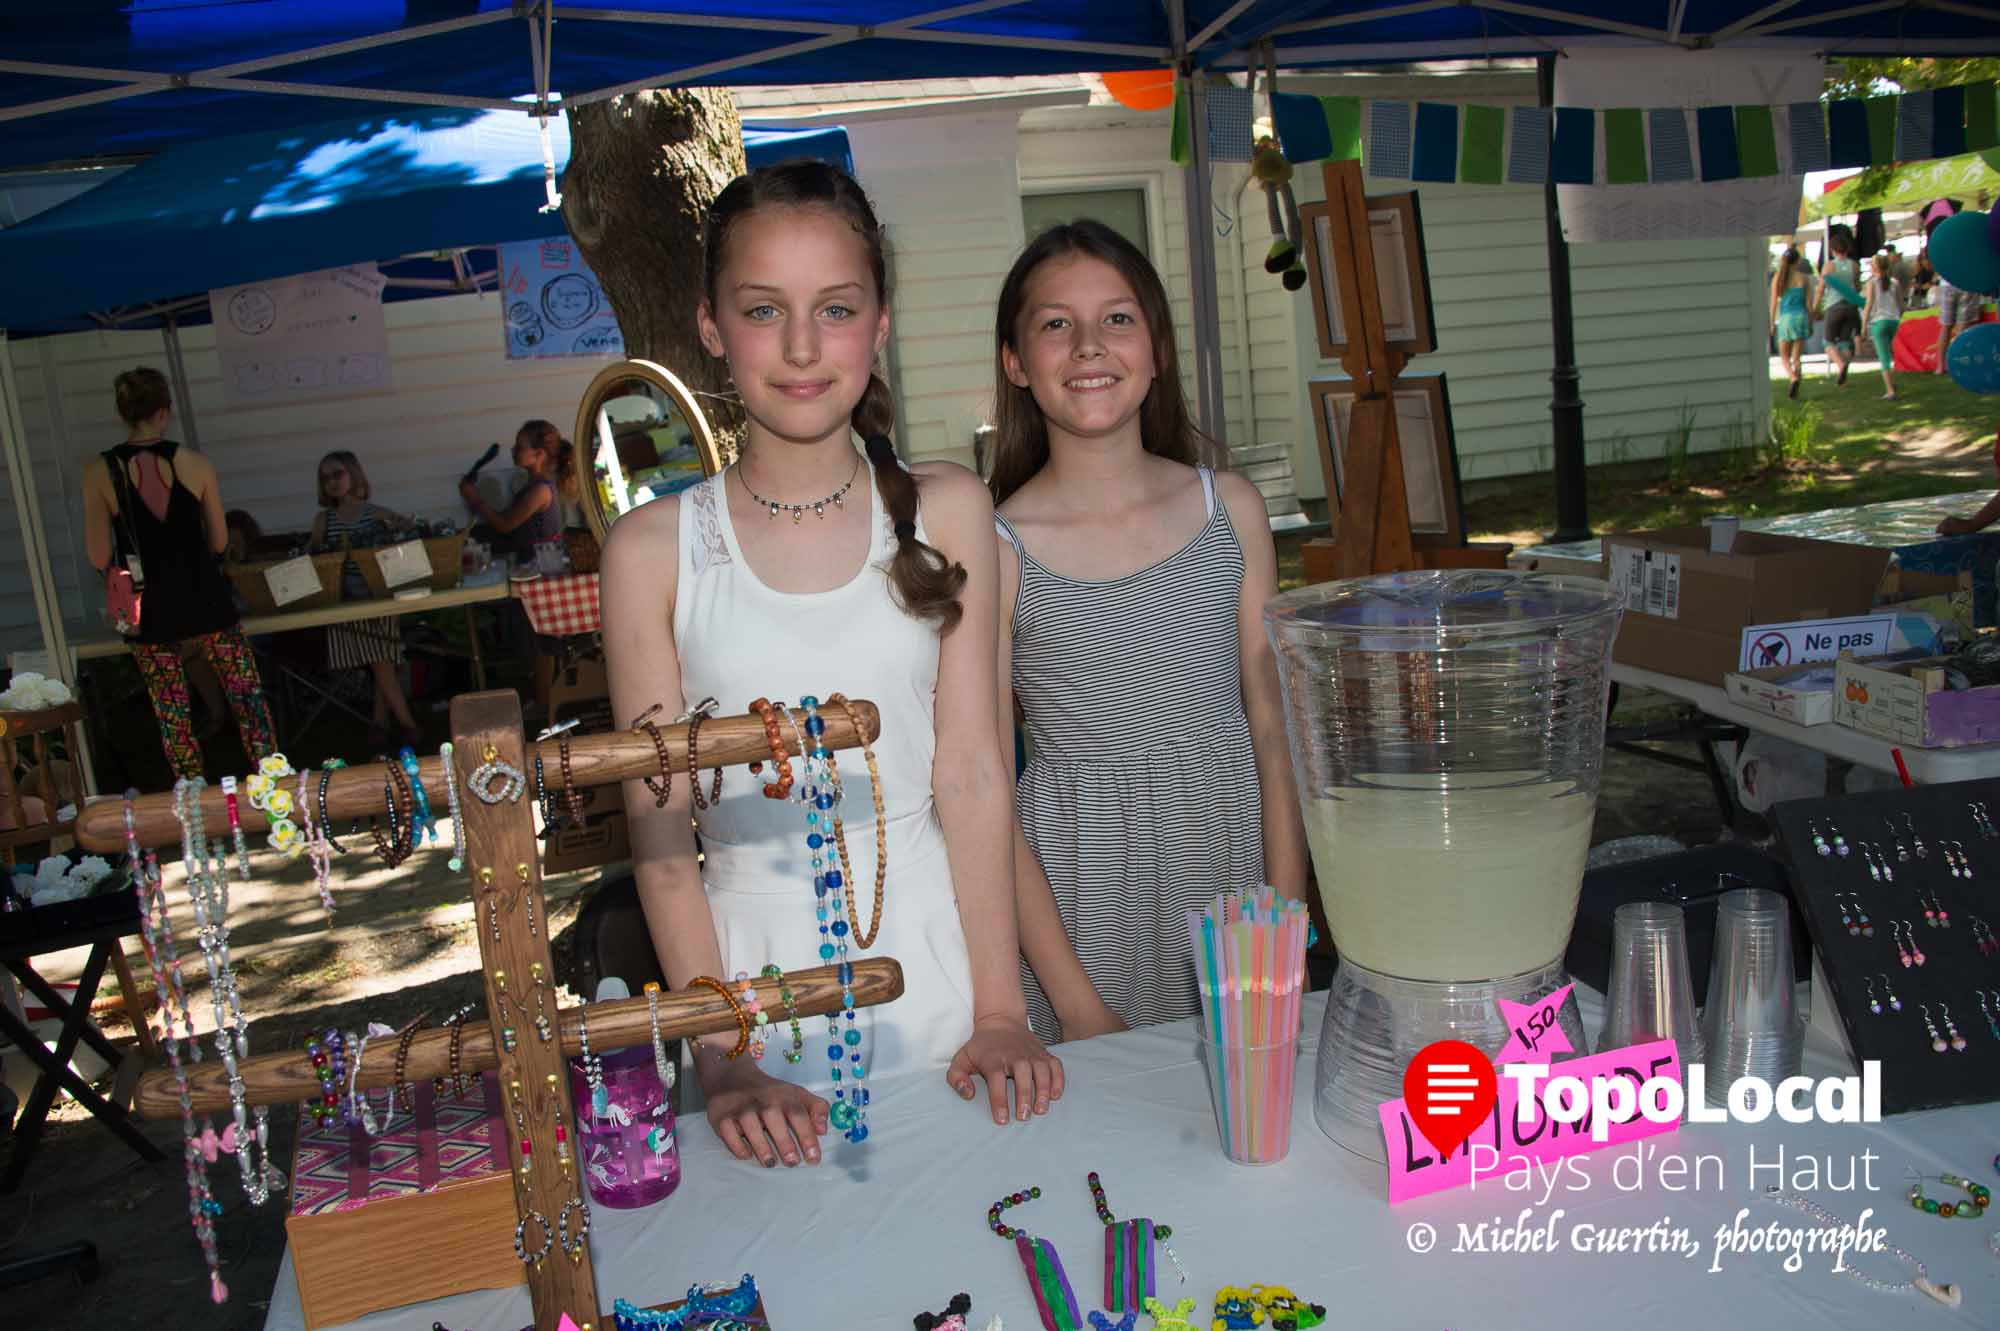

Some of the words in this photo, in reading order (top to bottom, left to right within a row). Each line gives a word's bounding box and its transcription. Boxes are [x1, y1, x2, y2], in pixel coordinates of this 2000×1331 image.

[1804, 632, 1833, 651] Ne
[1838, 631, 1874, 652] pas
[1514, 1004, 1556, 1053] 1,50
